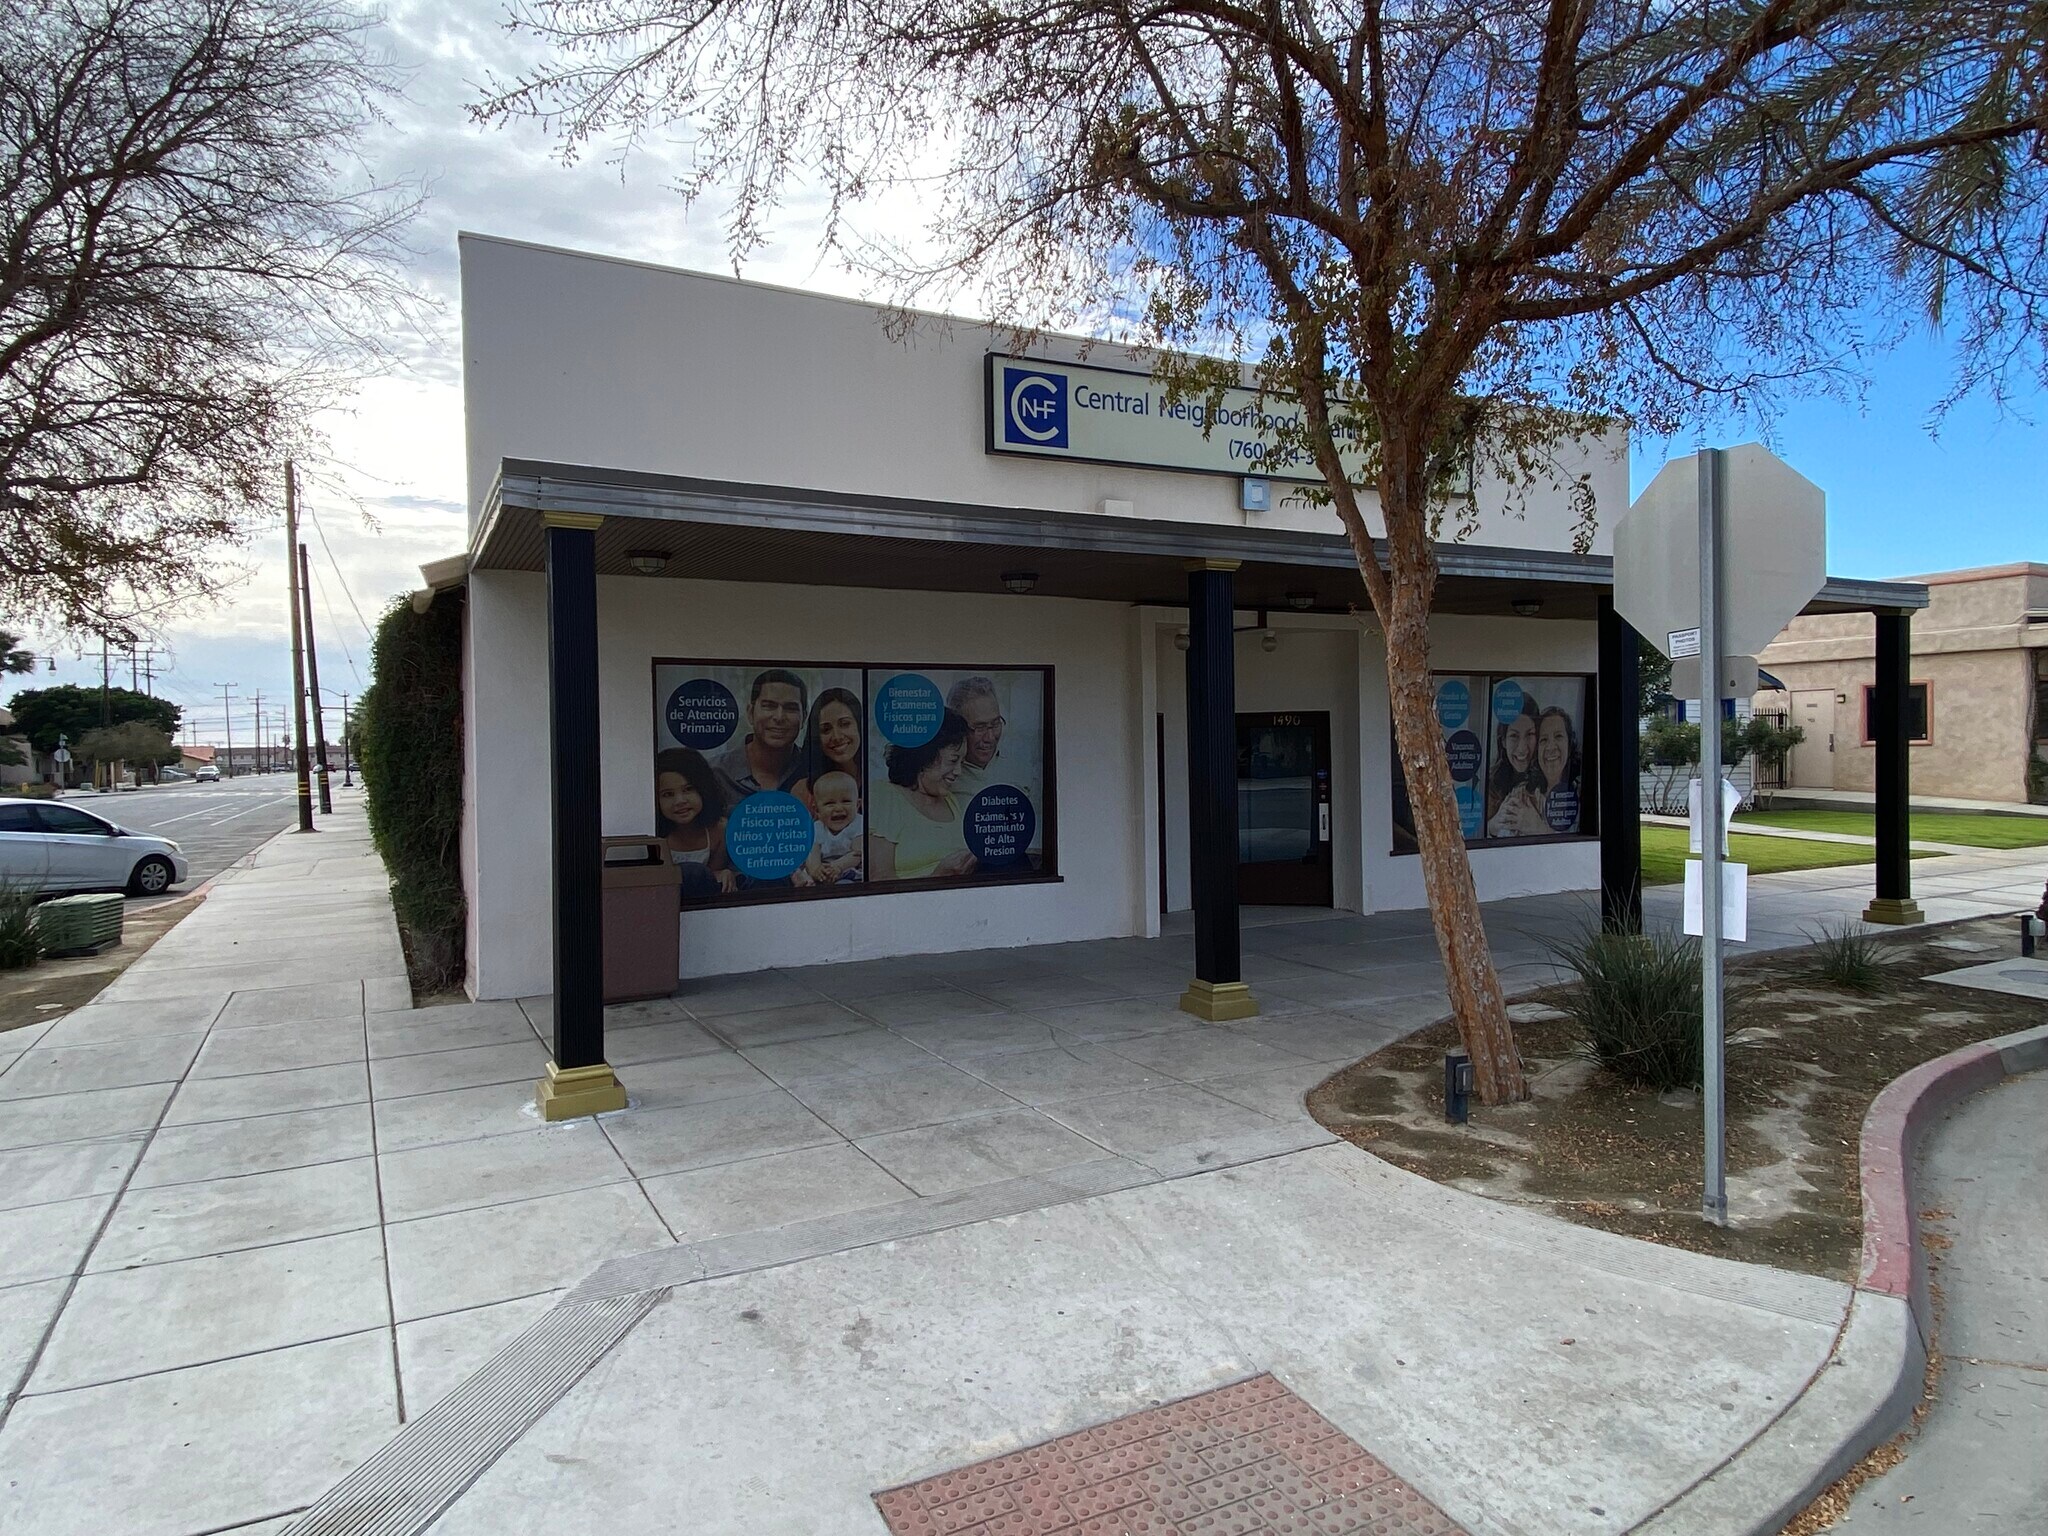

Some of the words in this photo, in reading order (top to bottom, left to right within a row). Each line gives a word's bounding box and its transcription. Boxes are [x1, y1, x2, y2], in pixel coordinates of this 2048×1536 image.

[1074, 385, 1149, 415] Central
[1160, 395, 1298, 431] Neigborhood
[1229, 439, 1267, 461] (760)
[1672, 631, 1697, 639] PASSPORT
[888, 687, 932, 698] Bienestar
[678, 696, 727, 707] Servicios
[882, 701, 889, 712] y
[670, 709, 684, 720] de
[687, 709, 735, 720] Atención
[915, 713, 937, 724] para
[1273, 715, 1301, 727] 1490
[680, 722, 726, 733] Primaria
[892, 723, 928, 734] Adultos
[981, 796, 1018, 806] Diabetes
[745, 803, 797, 815] Exámenes
[1019, 812, 1025, 822] y
[777, 817, 800, 829] para
[733, 830, 763, 842] Niños
[766, 832, 773, 844] y
[775, 829, 807, 841] visitas
[984, 835, 996, 845] de
[997, 834, 1015, 844] Alta
[735, 844, 775, 856] Cuando
[778, 842, 806, 853] Estan
[984, 845, 1015, 857] Presion
[747, 857, 795, 868] Enfermos
